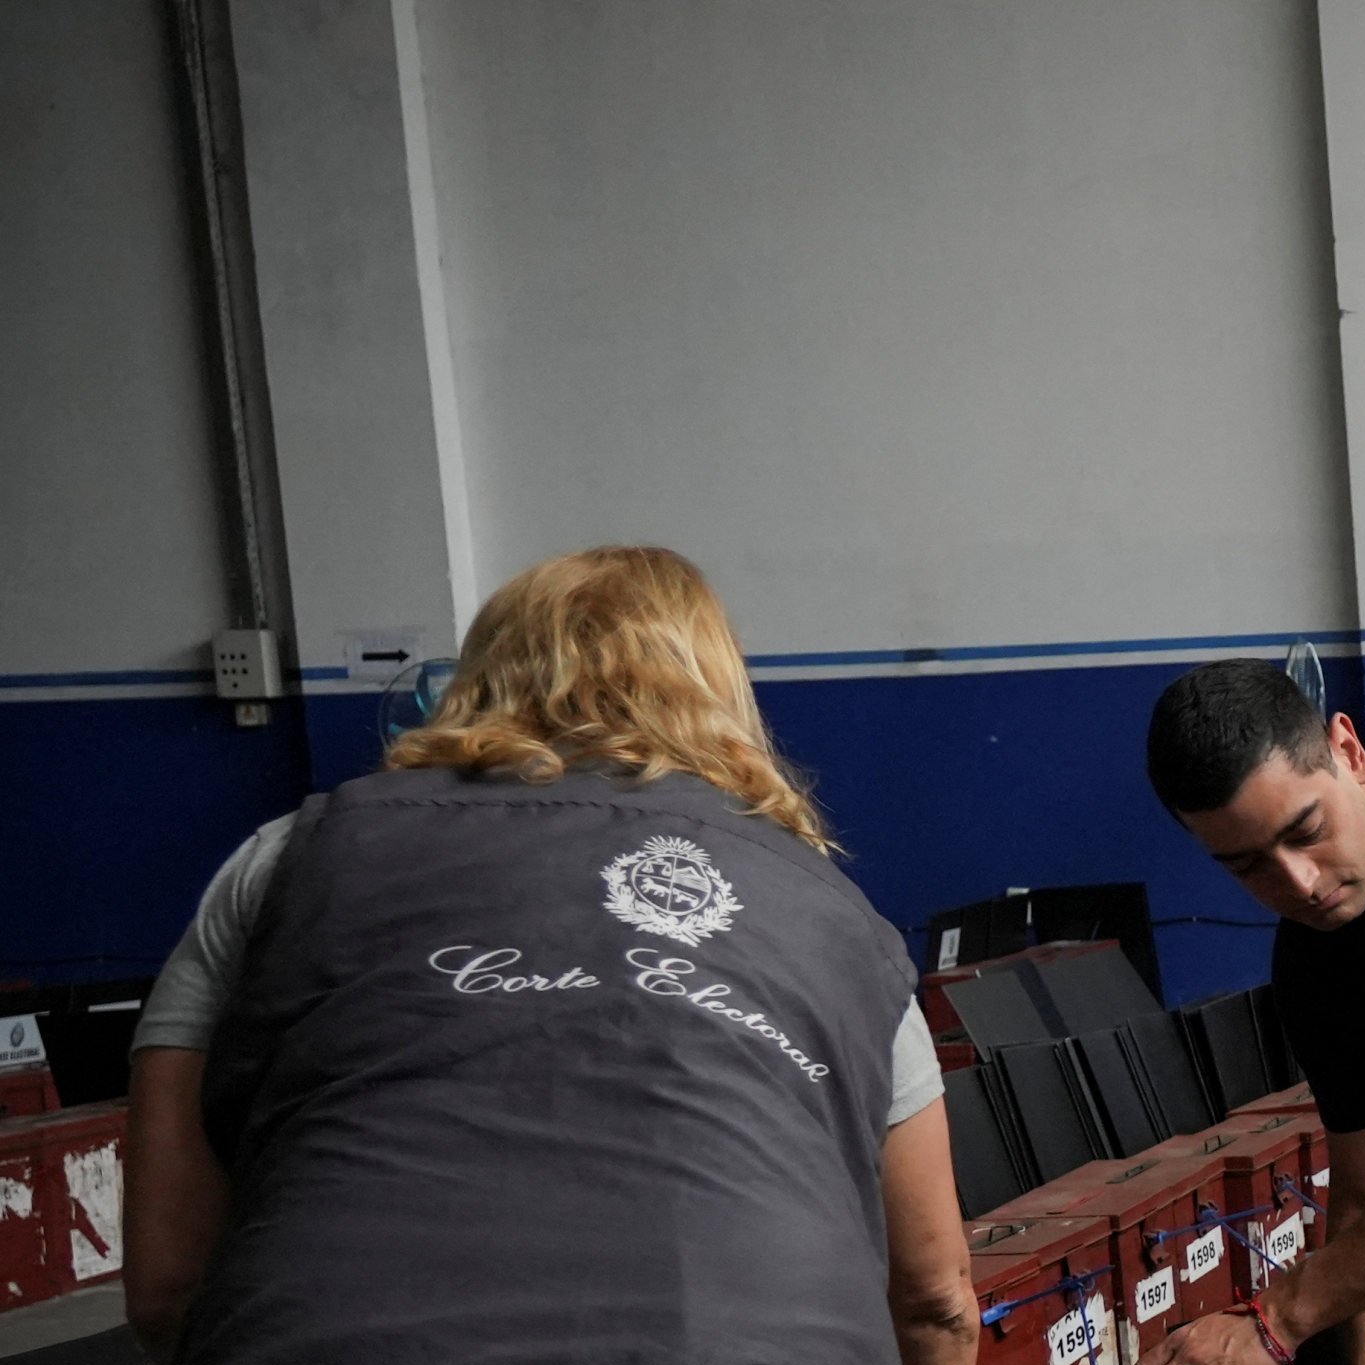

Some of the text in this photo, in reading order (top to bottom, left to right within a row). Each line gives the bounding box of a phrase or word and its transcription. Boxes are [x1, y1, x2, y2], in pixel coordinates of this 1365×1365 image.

[428, 945, 830, 1083] Corte Electoral
[1190, 1241, 1216, 1270] 1598
[1271, 1231, 1295, 1256] 1599
[1141, 1281, 1167, 1310] 1597
